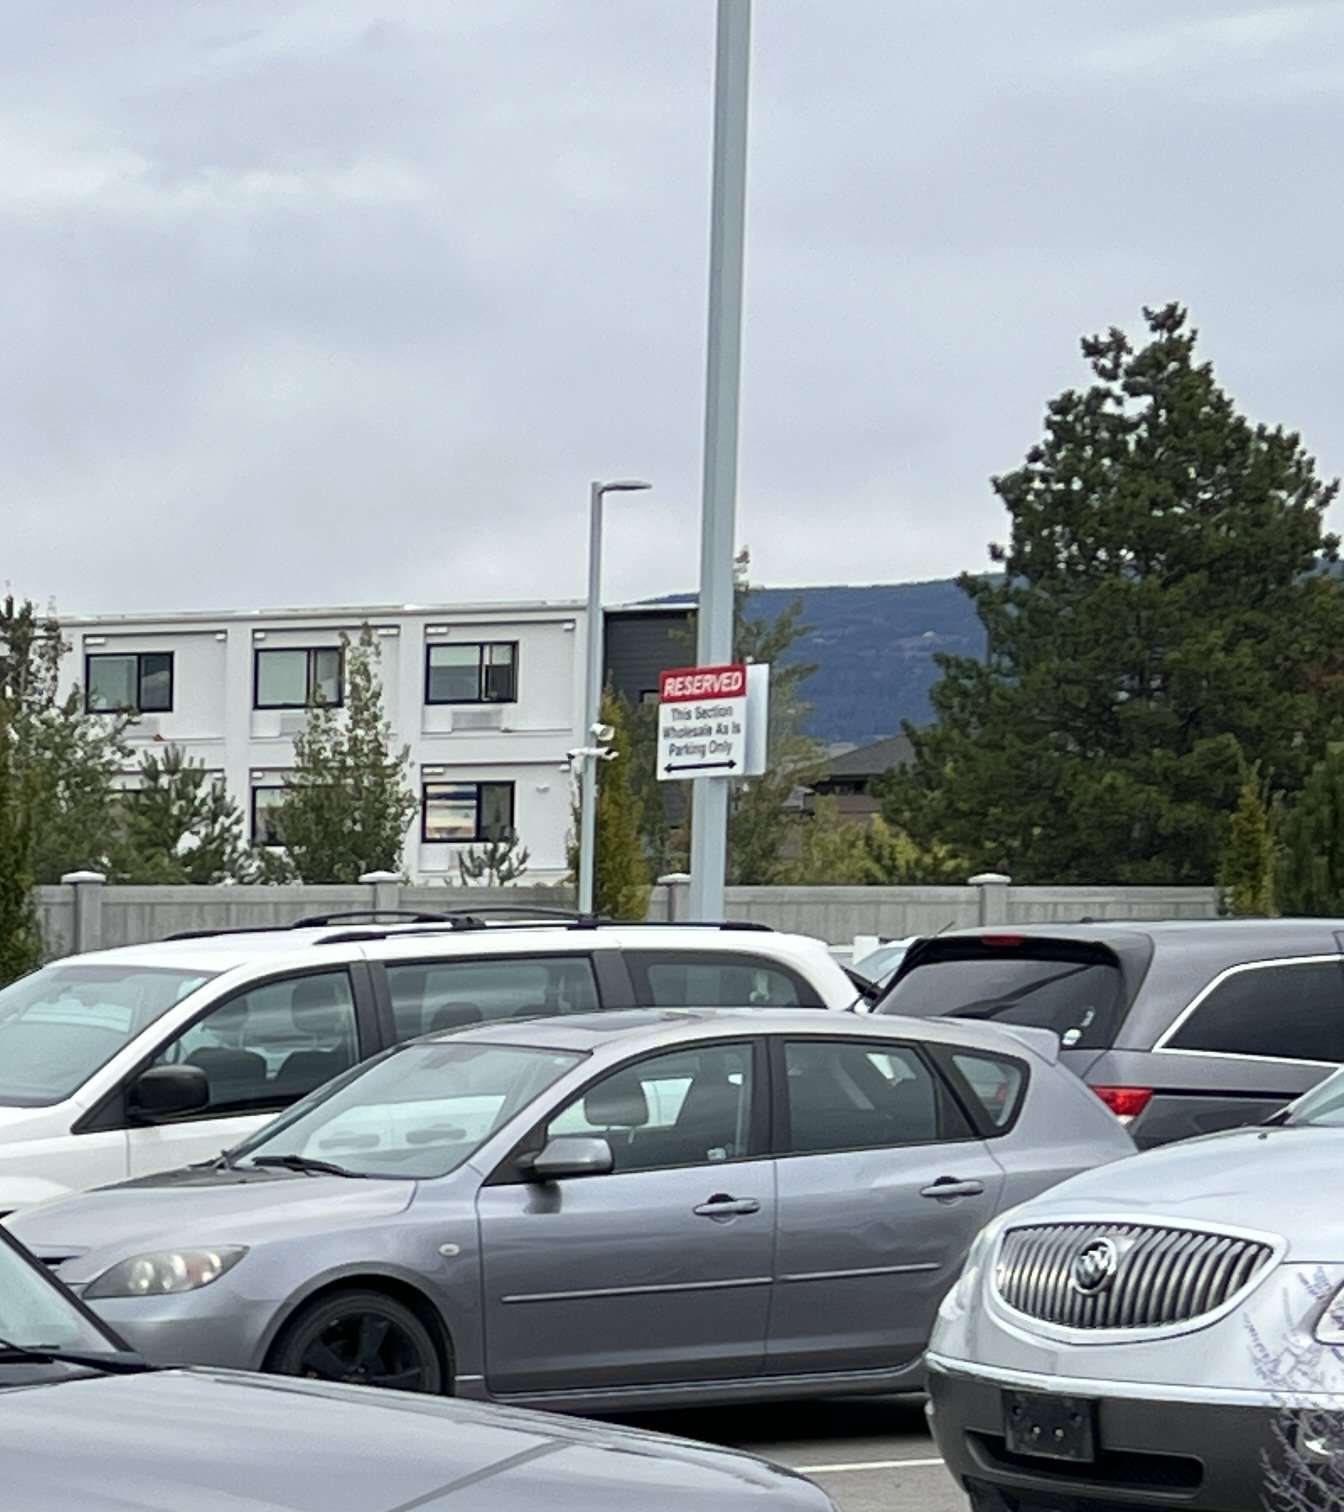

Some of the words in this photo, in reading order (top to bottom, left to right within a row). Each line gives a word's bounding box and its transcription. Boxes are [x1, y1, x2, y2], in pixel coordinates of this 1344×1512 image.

[664, 672, 742, 697] RESERVED
[671, 707, 691, 721] This
[694, 704, 733, 720] Section
[715, 722, 729, 735] As
[668, 742, 706, 759] Parking
[708, 740, 732, 756] Only
